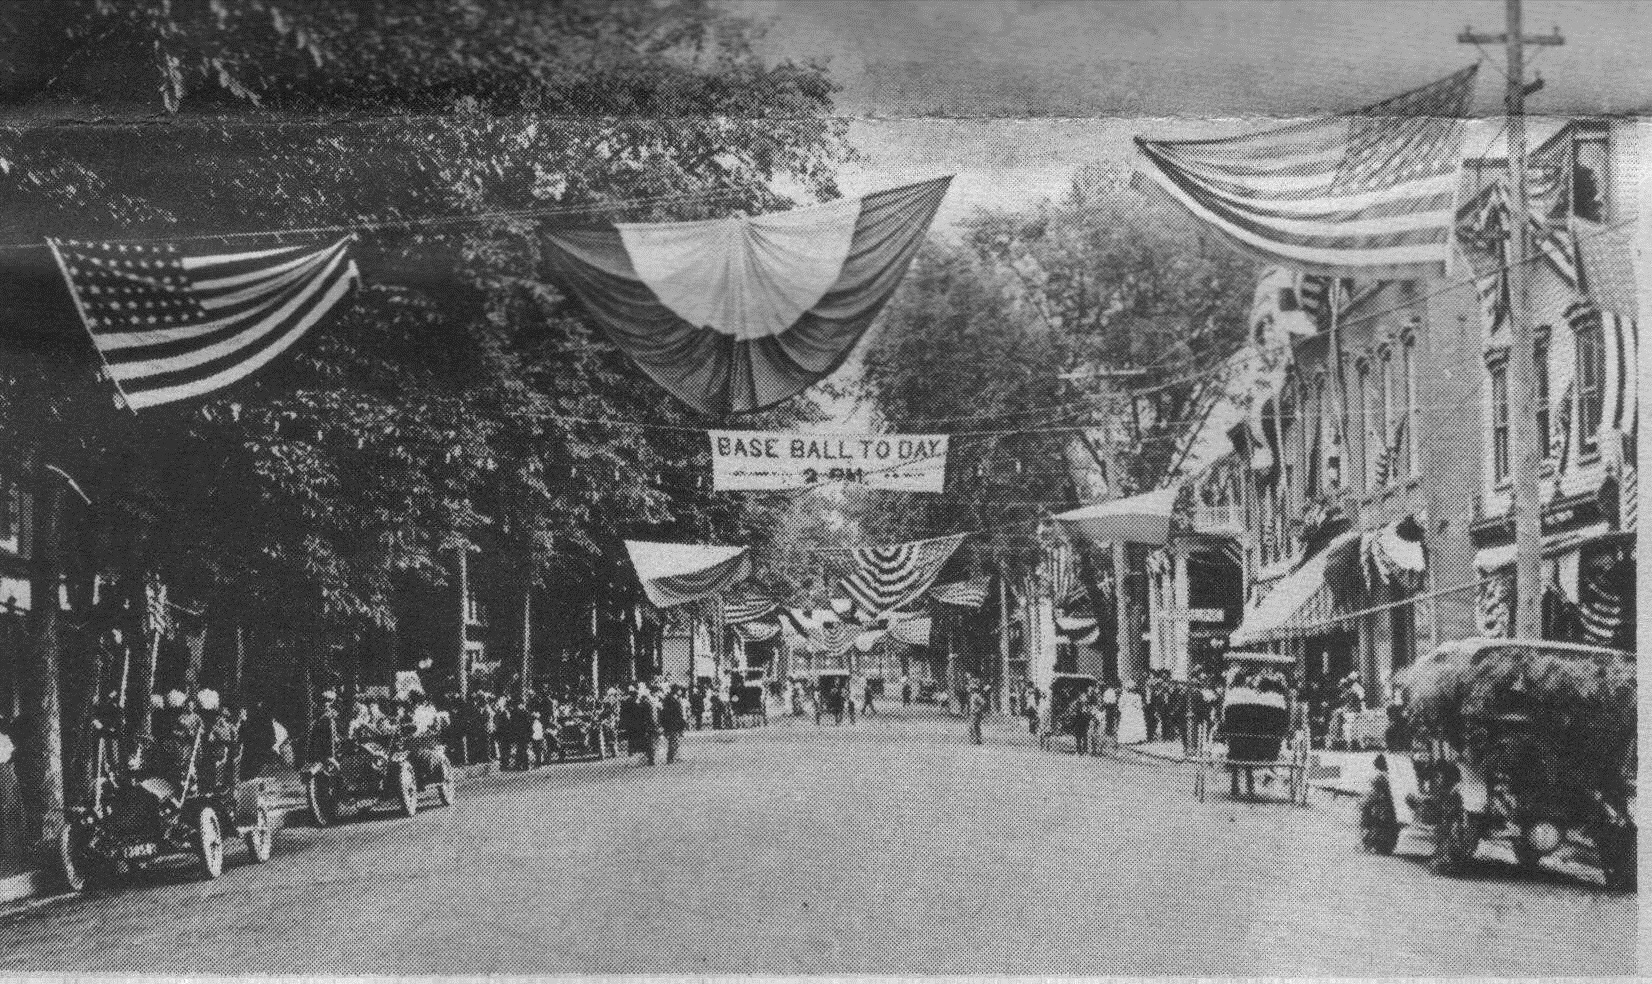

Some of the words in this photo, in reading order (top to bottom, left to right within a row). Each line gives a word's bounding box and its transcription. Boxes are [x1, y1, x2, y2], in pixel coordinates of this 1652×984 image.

[717, 436, 779, 459] BASE
[790, 438, 853, 460] BALL
[859, 439, 891, 459] TO
